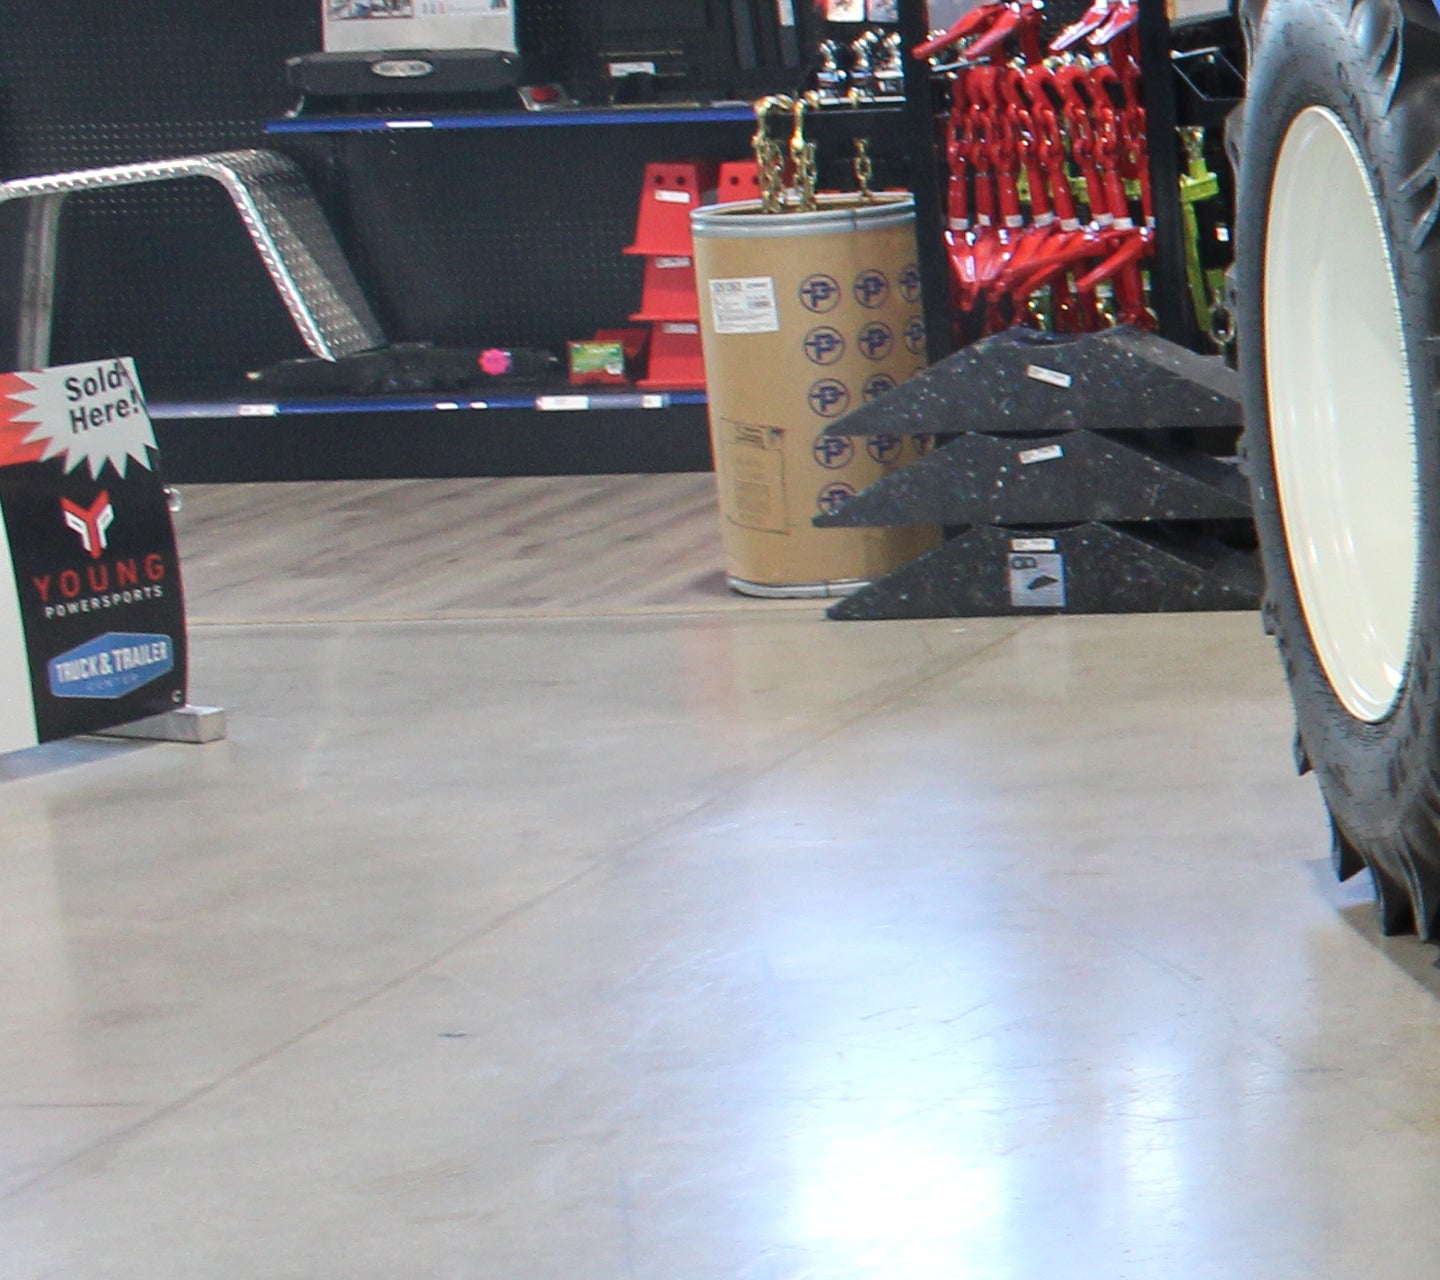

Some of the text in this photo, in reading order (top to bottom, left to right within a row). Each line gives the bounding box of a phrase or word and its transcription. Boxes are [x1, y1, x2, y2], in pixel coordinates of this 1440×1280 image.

[65, 362, 124, 402] Sold
[69, 389, 139, 435] Here!
[32, 553, 165, 602] YOUNG
[44, 584, 164, 620] POWERSPORTS
[55, 655, 99, 684] TRUCK
[111, 640, 168, 672] TRAILER
